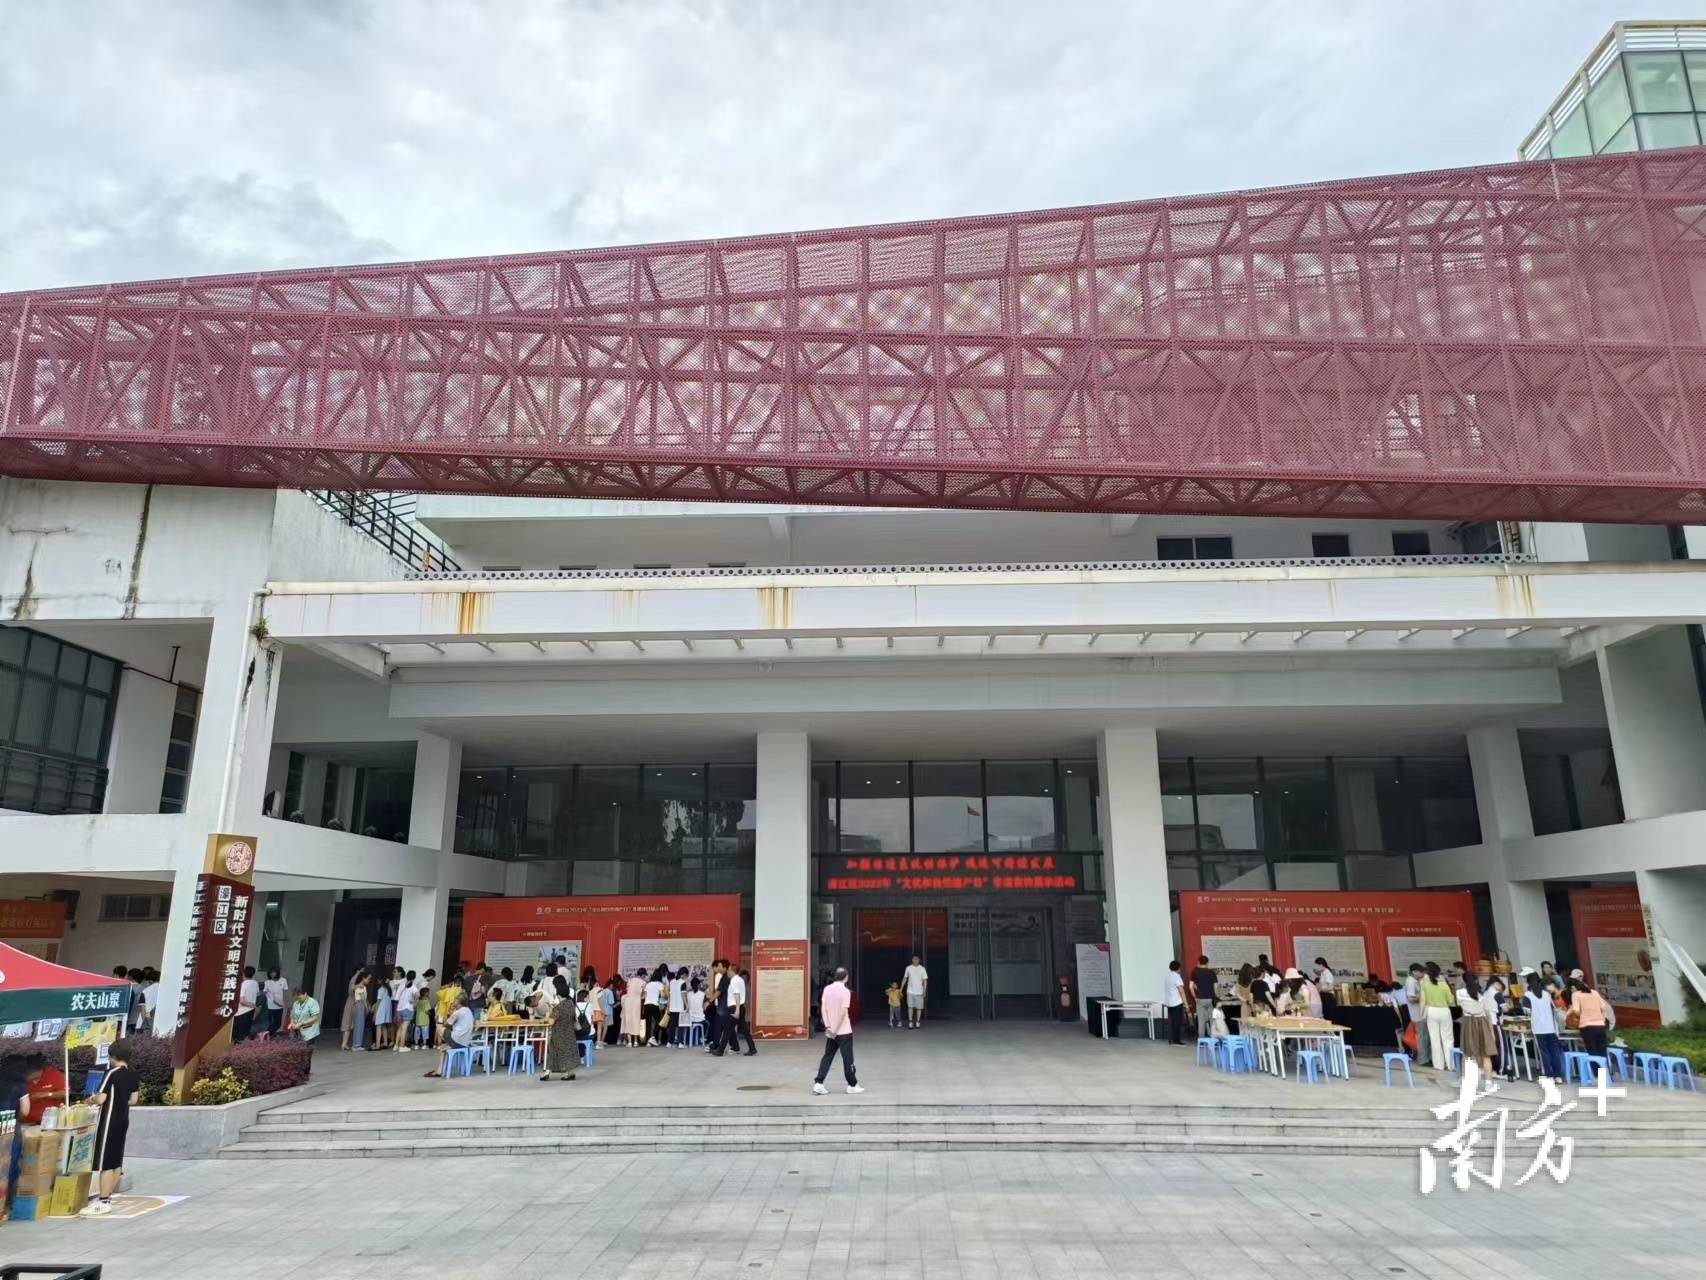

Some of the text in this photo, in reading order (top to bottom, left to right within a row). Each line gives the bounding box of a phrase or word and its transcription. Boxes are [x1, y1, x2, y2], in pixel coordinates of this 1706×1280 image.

[213, 885, 232, 935] 濠江区
[219, 896, 249, 1018] 新时代文明实践中心
[70, 991, 121, 1012] 农夫山泉
